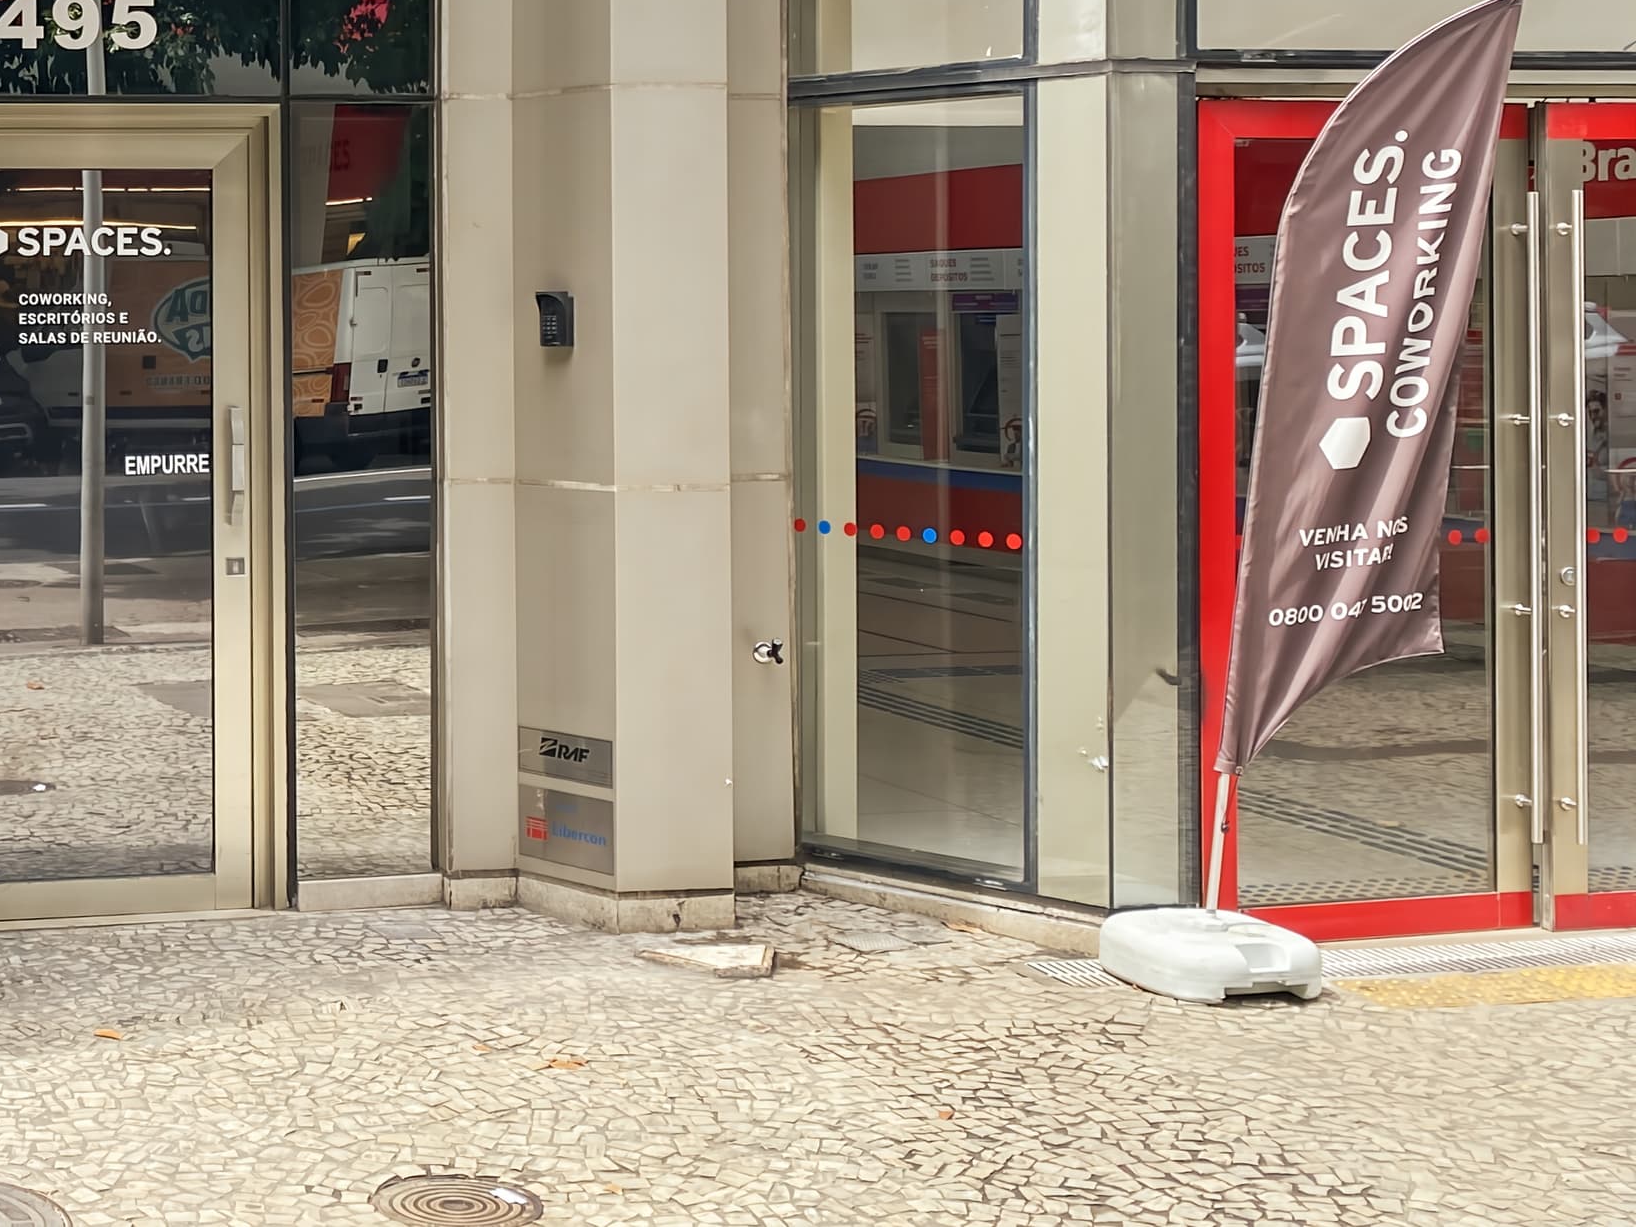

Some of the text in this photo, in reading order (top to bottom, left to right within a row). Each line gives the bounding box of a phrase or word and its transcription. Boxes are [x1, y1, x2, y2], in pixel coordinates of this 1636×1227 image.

[17, 227, 172, 257] SPACES.
[1326, 129, 1409, 401] SPACES.
[19, 293, 112, 307] COWORKING,
[1386, 148, 1462, 438] COWORKING
[19, 309, 129, 325] ESCRITÓRIOS E
[19, 329, 162, 344] SALAS DE REUNIÃO.
[124, 453, 210, 476] EMPURRE
[1299, 523, 1368, 547] VENHA
[1268, 604, 1324, 627] 0800
[1371, 592, 1423, 614] 5002
